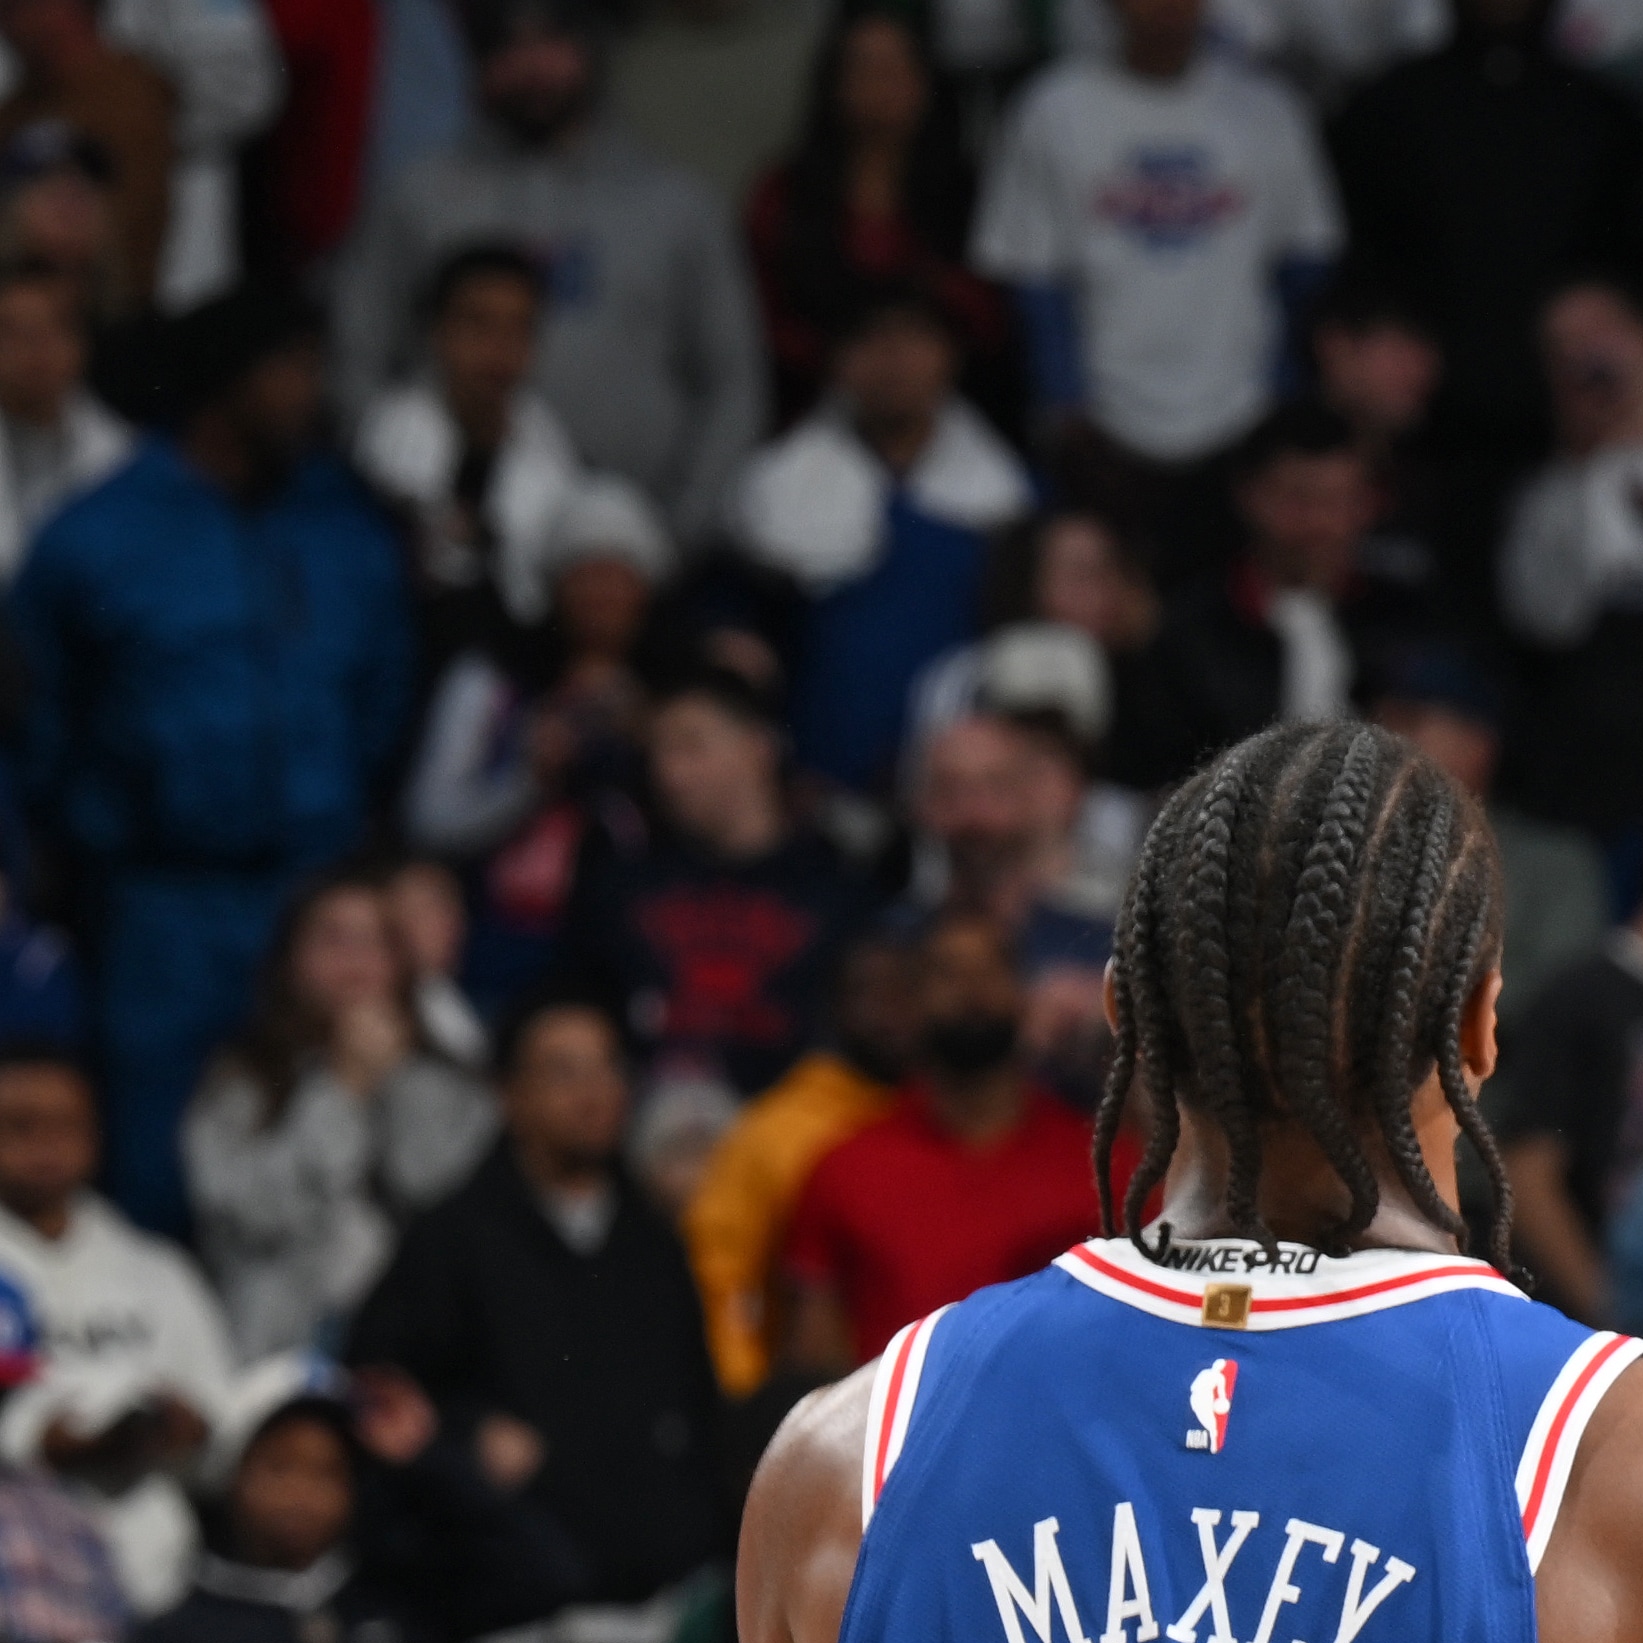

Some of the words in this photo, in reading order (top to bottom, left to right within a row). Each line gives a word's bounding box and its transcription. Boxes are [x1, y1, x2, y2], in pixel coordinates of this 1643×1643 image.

[1164, 1247, 1244, 1273] NIKE
[1246, 1249, 1321, 1275] PRO
[1185, 1428, 1209, 1450] NBA
